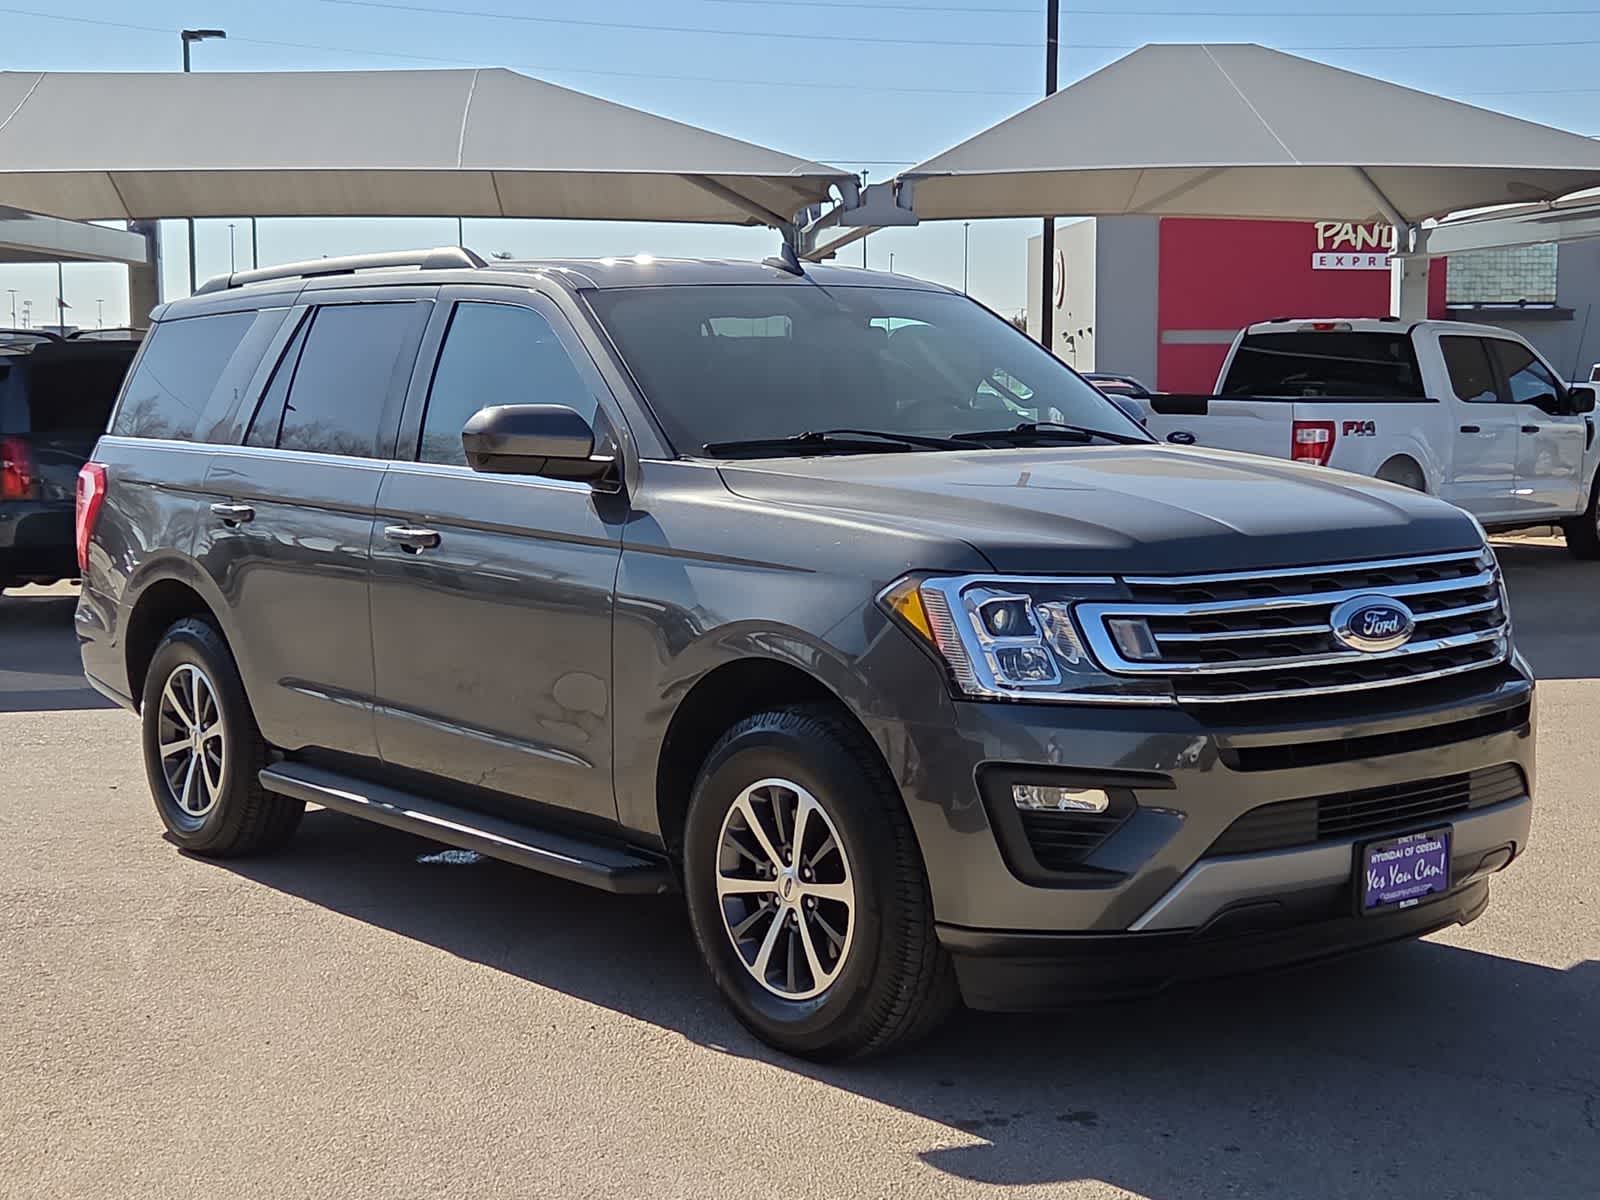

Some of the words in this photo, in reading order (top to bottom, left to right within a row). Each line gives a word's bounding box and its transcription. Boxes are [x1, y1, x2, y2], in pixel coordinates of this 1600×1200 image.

[1314, 221, 1393, 251] PAND
[1319, 256, 1392, 267] EXPRE
[1342, 420, 1376, 436] FX4
[1363, 610, 1399, 635] Ford
[1371, 849, 1403, 864] HYUNDAI
[1404, 846, 1415, 857] OF
[1415, 841, 1442, 854] ODESSA
[1366, 868, 1386, 892] Yes
[1389, 863, 1412, 887] You
[1414, 853, 1446, 880] Can!
